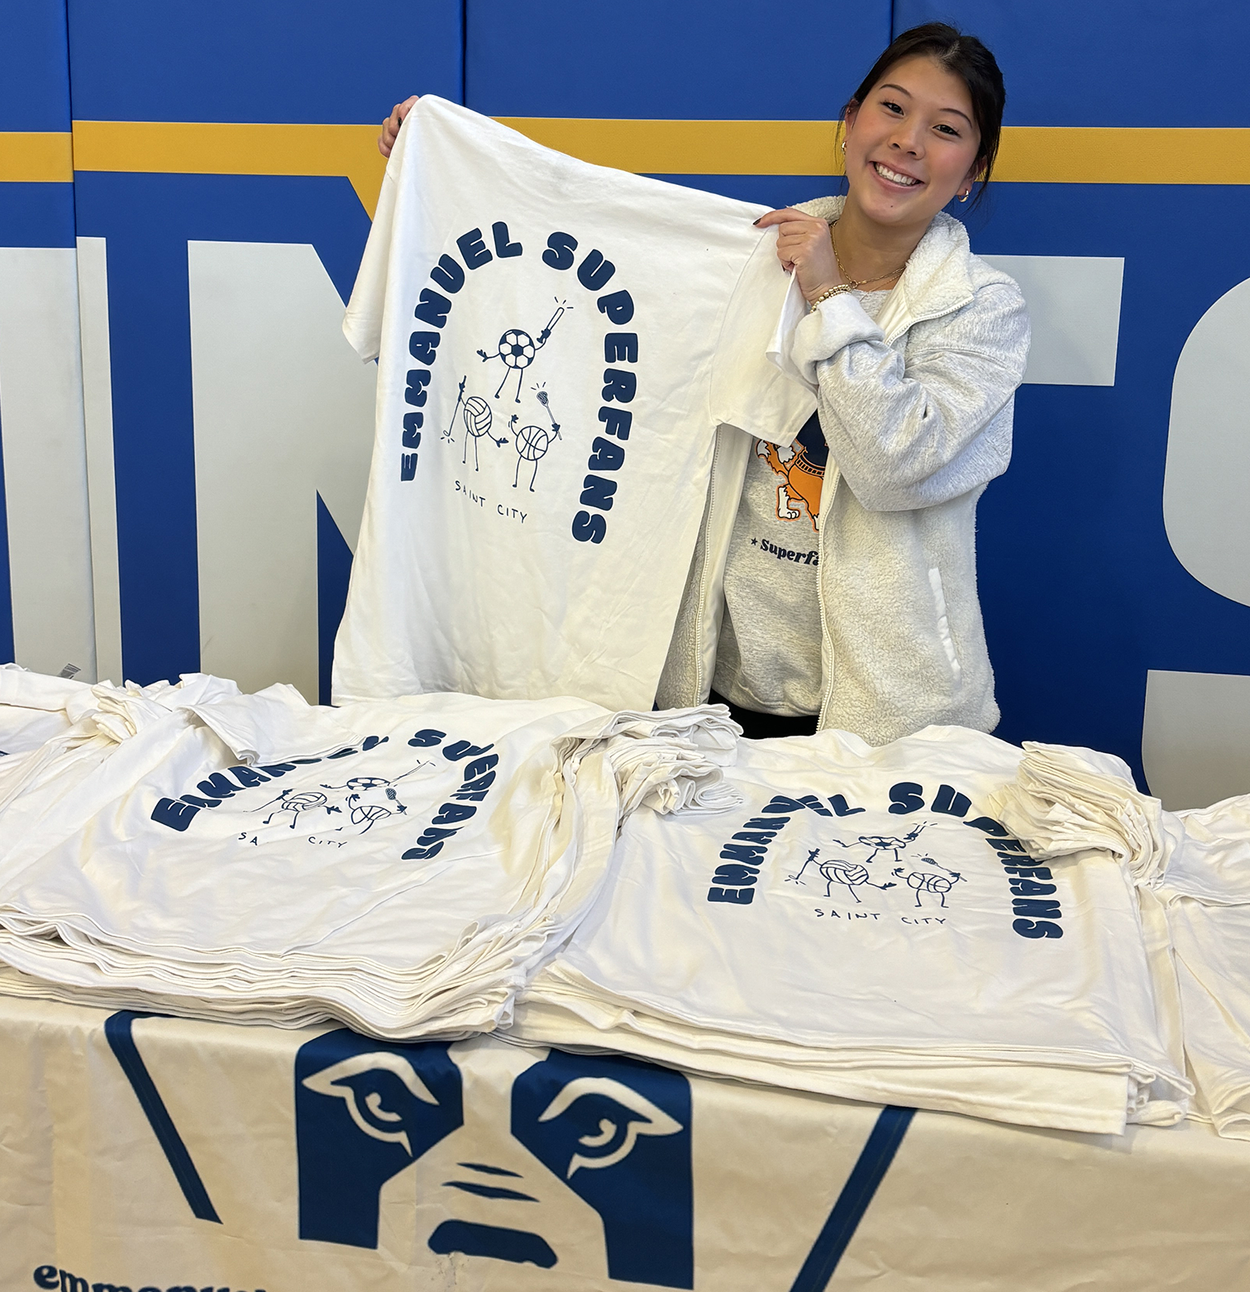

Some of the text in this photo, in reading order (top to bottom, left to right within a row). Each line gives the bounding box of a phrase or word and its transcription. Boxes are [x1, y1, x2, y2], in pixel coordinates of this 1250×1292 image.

[400, 221, 639, 545] EMMANUEL SUPERFANS
[455, 479, 529, 524] SAINT CITY
[814, 907, 947, 926] SAINT CITY
